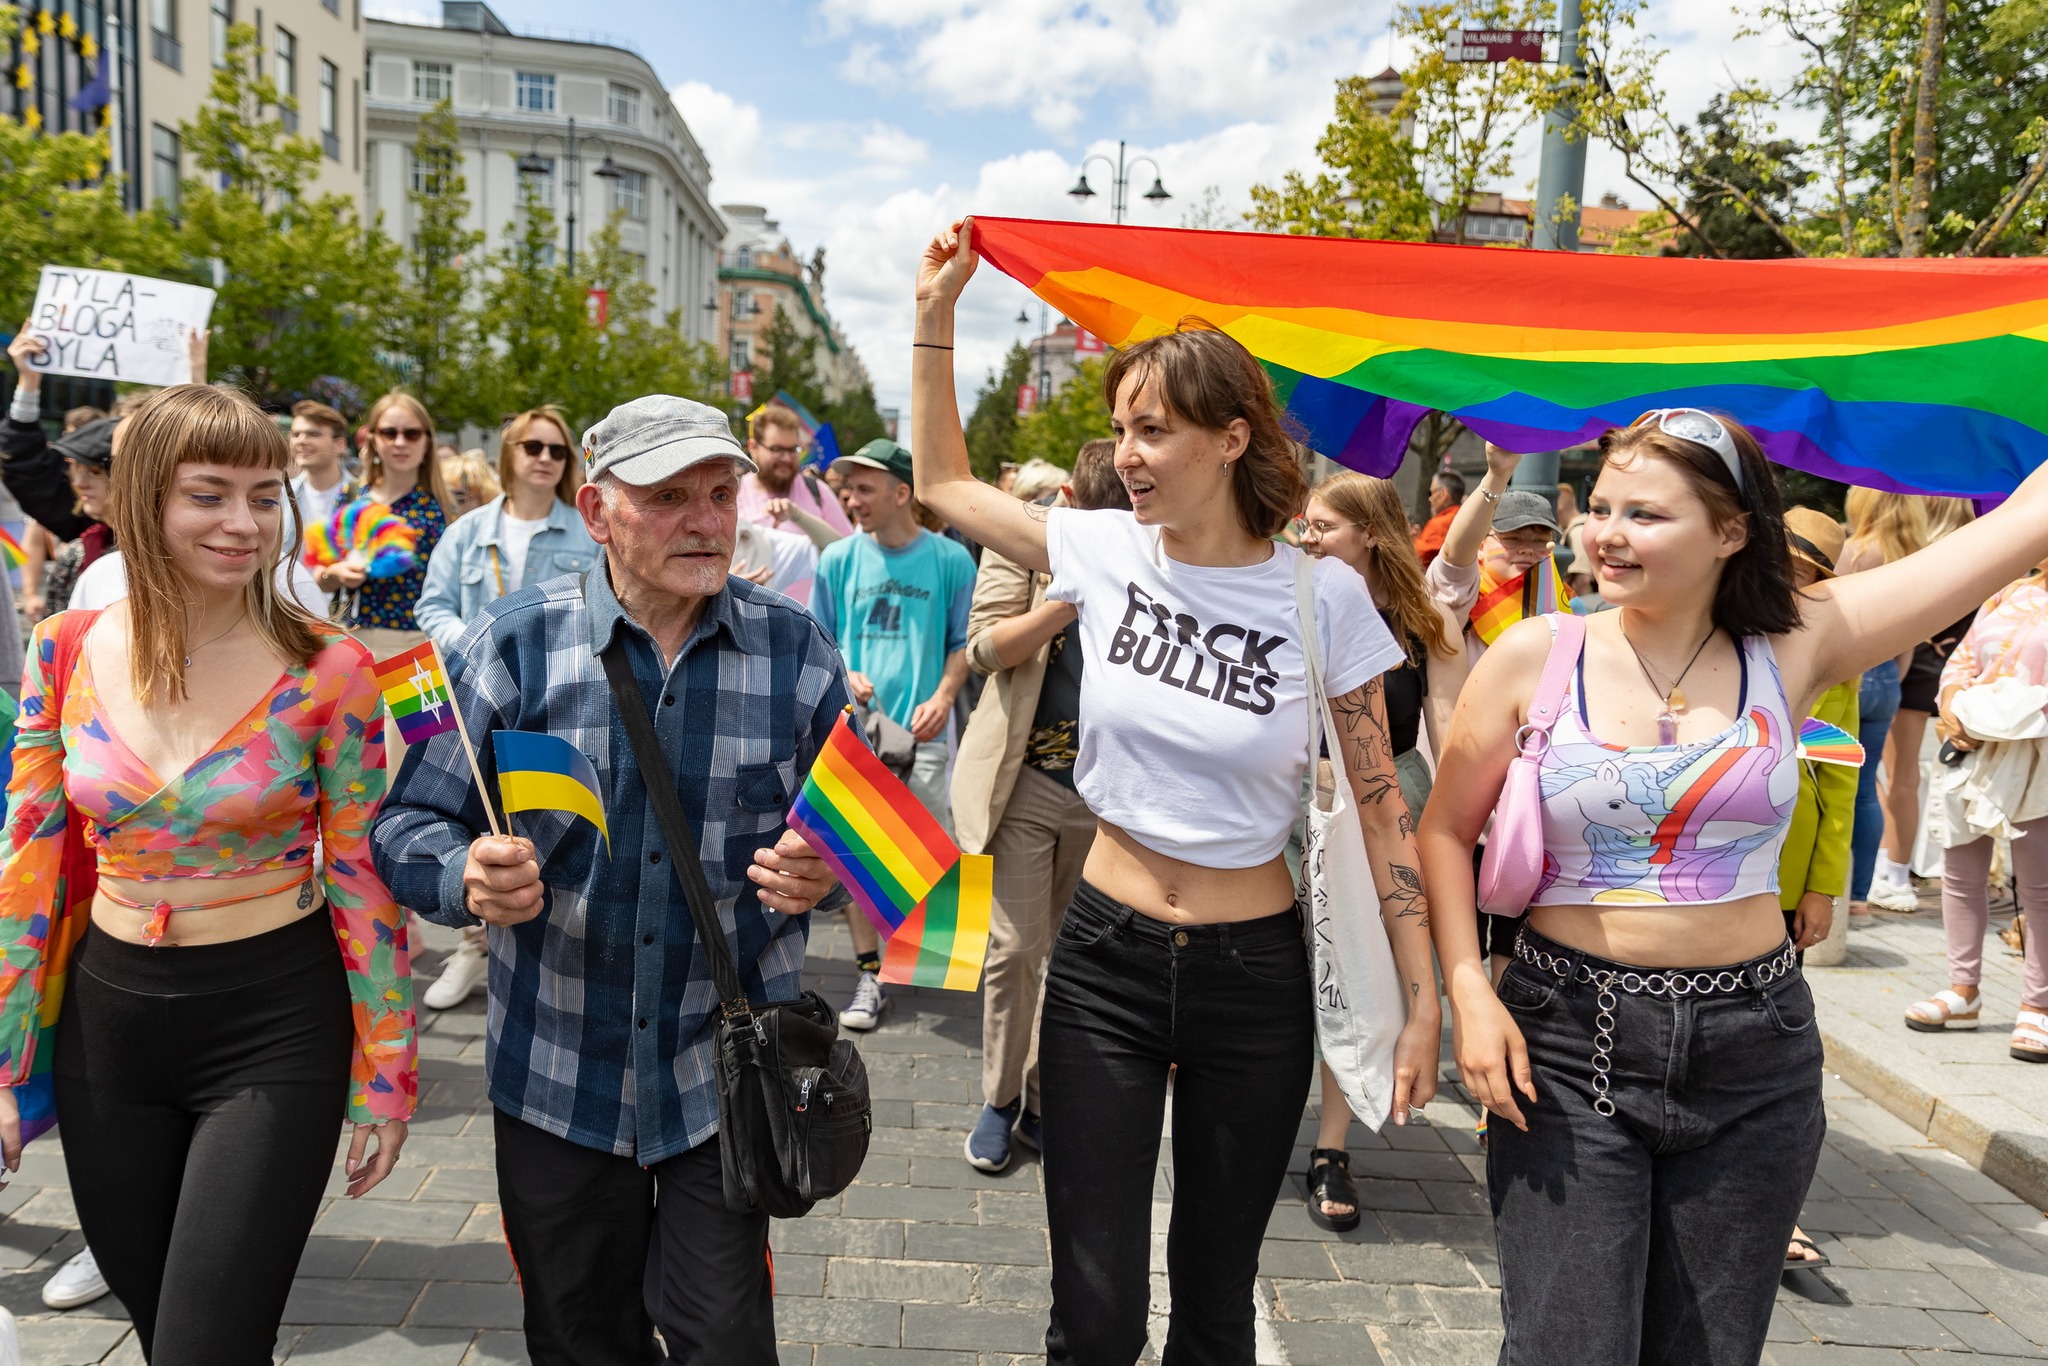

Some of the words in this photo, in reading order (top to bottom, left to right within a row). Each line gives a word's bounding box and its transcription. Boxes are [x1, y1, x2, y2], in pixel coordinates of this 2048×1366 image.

[1463, 32, 1513, 44] VILNIAUS
[35, 303, 136, 343] BLOGA
[30, 334, 119, 376] BYLA
[1107, 625, 1278, 715] BULLIES
